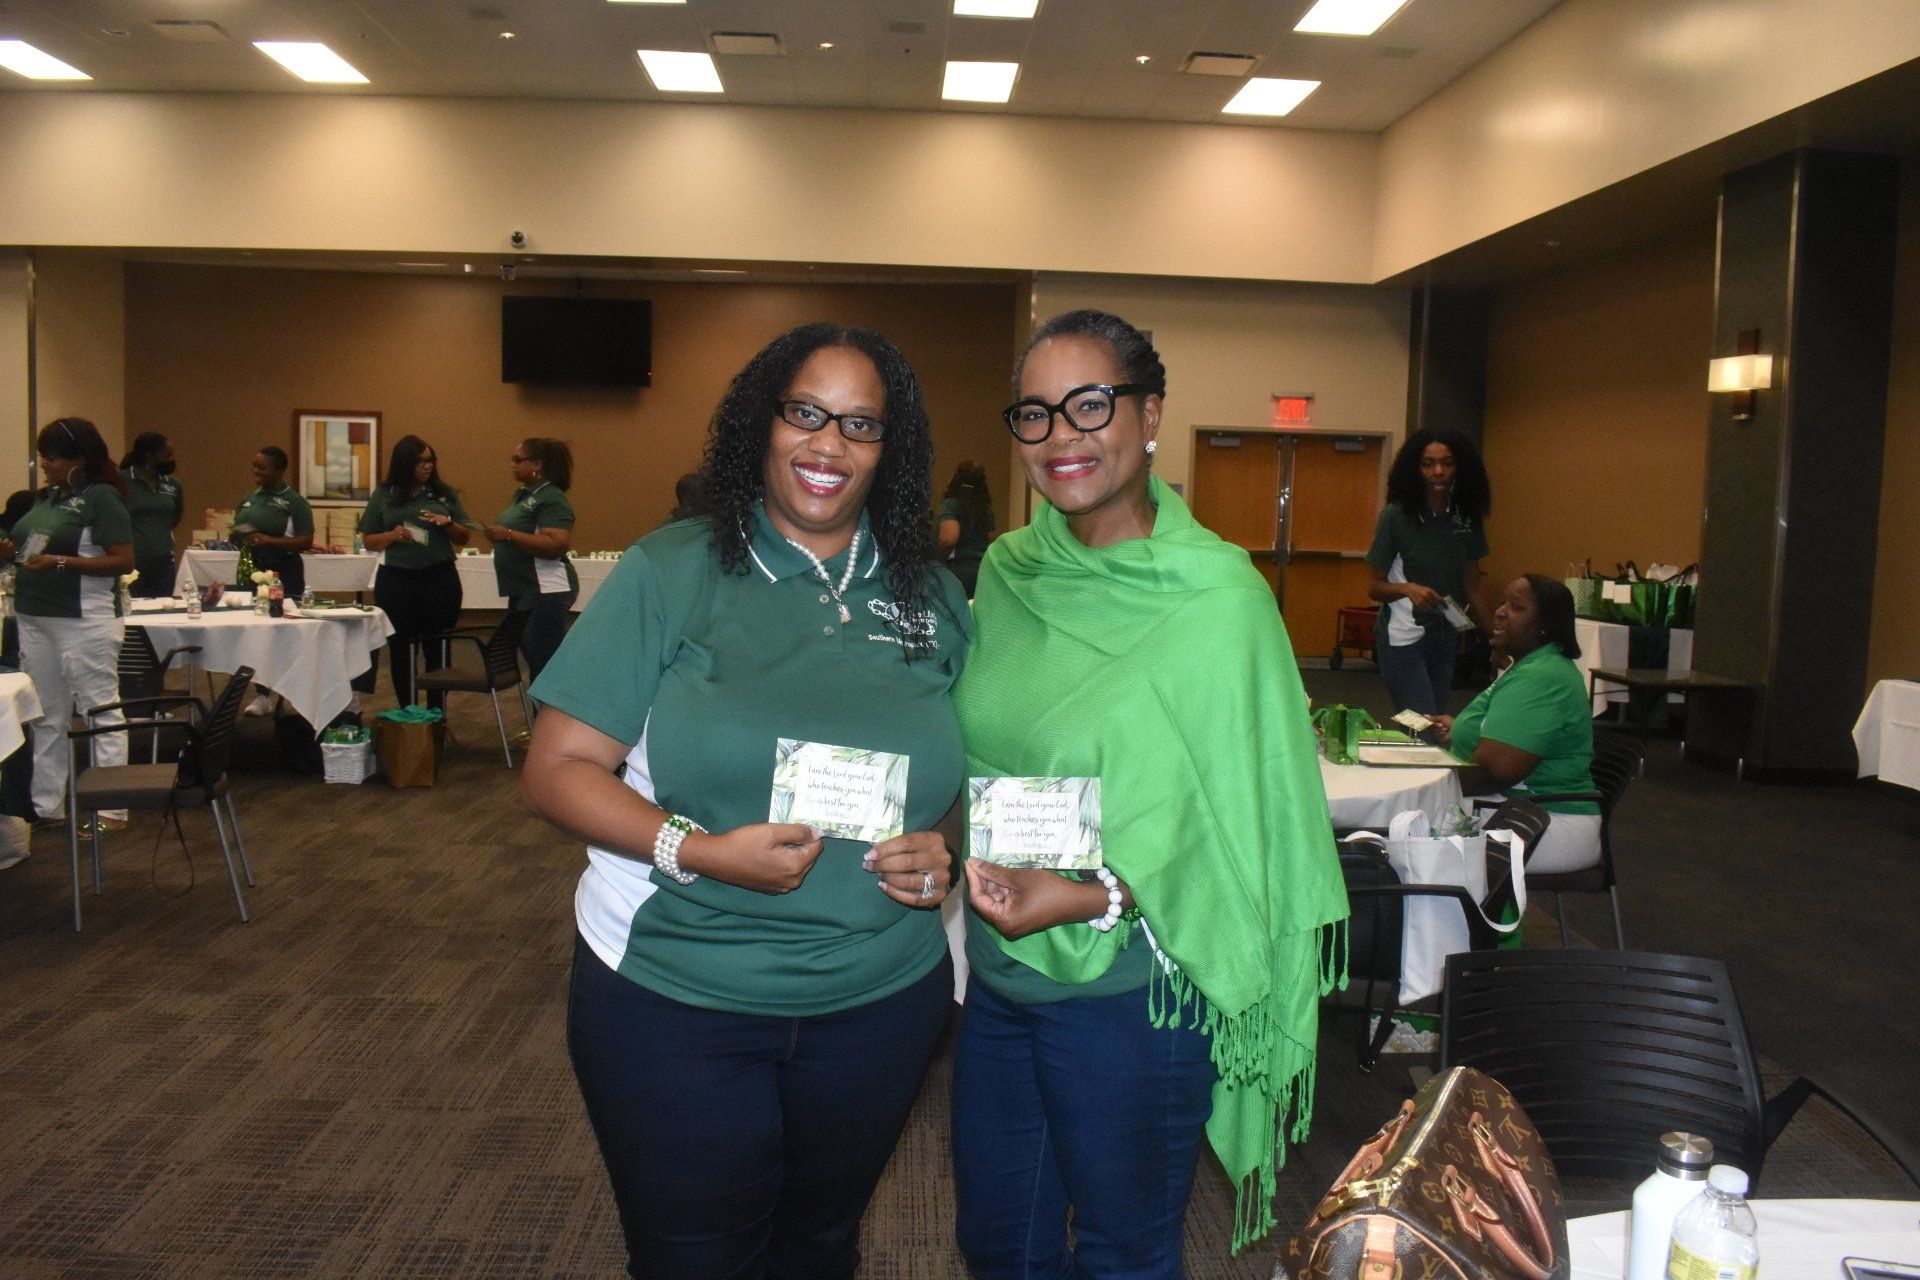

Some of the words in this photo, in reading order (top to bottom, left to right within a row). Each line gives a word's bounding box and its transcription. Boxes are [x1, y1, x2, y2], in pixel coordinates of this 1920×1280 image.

[823, 765, 832, 775] the
[834, 769, 848, 778] Lord
[847, 774, 861, 783] your
[808, 778, 821, 788] who
[821, 782, 843, 792] teaches
[845, 787, 856, 797] you
[857, 786, 872, 796] what
[824, 795, 837, 805] best
[837, 797, 845, 807] for
[1016, 799, 1025, 808] the
[1026, 800, 1040, 809] Lord
[1040, 802, 1054, 812] your
[1003, 814, 1016, 823] who
[1016, 814, 1038, 823] teaches
[1040, 817, 1051, 828] you
[1051, 814, 1067, 823] what
[1021, 829, 1033, 838] best
[1034, 828, 1042, 838] for
